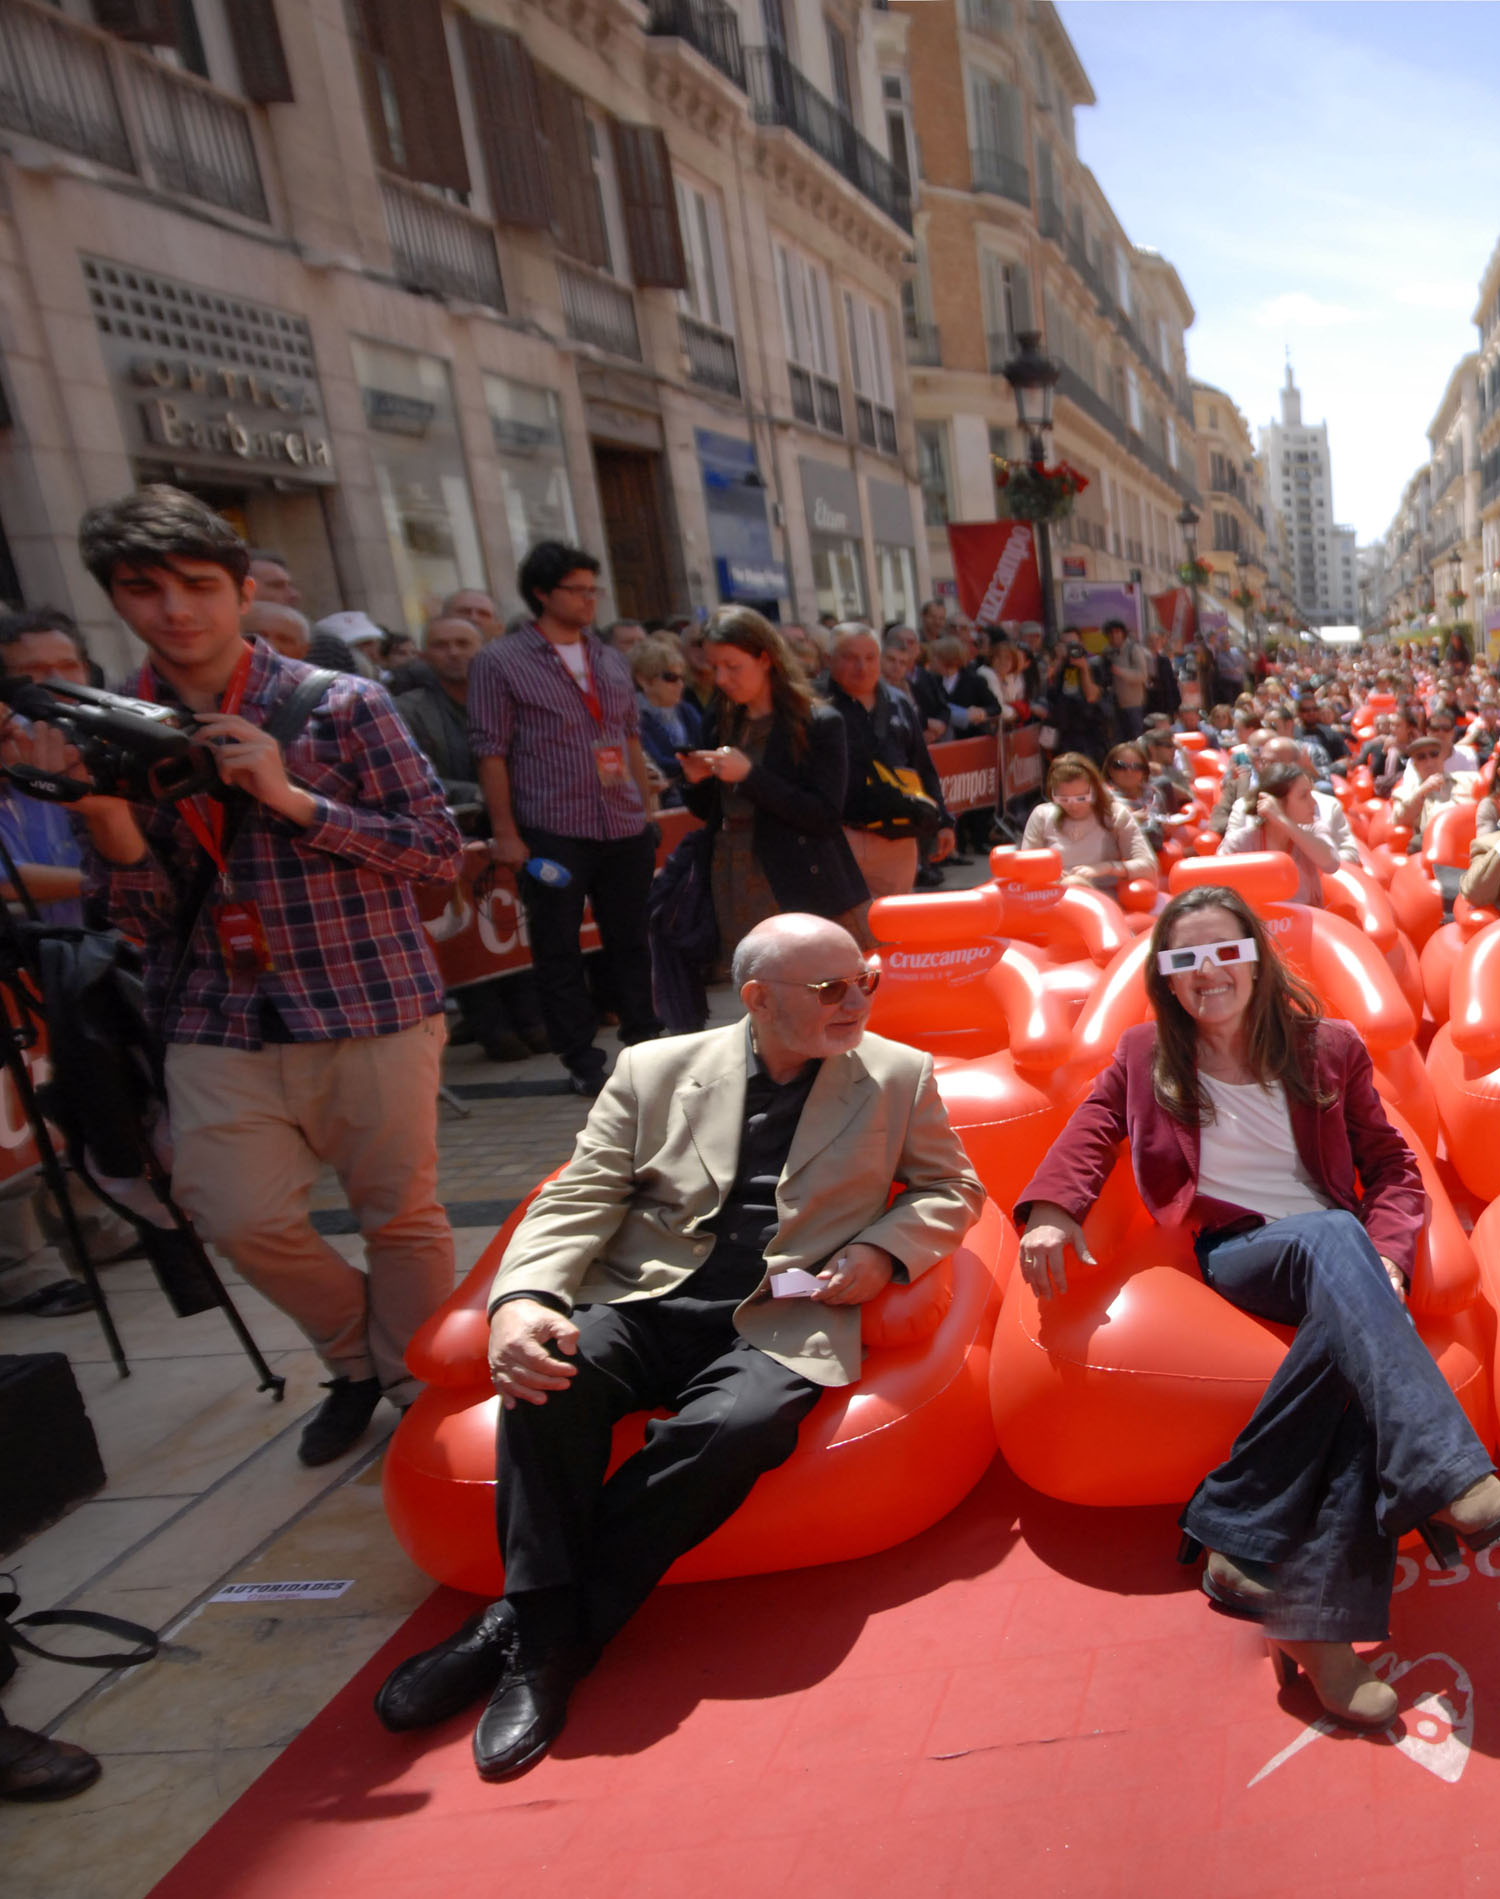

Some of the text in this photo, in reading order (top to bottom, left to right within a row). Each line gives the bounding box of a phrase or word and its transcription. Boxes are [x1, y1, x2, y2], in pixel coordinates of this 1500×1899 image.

[30, 779, 57, 792] JVC
[940, 770, 987, 803] campo
[889, 946, 993, 969] Cruzcampo
[221, 1582, 347, 1594] AUTORIDADES
